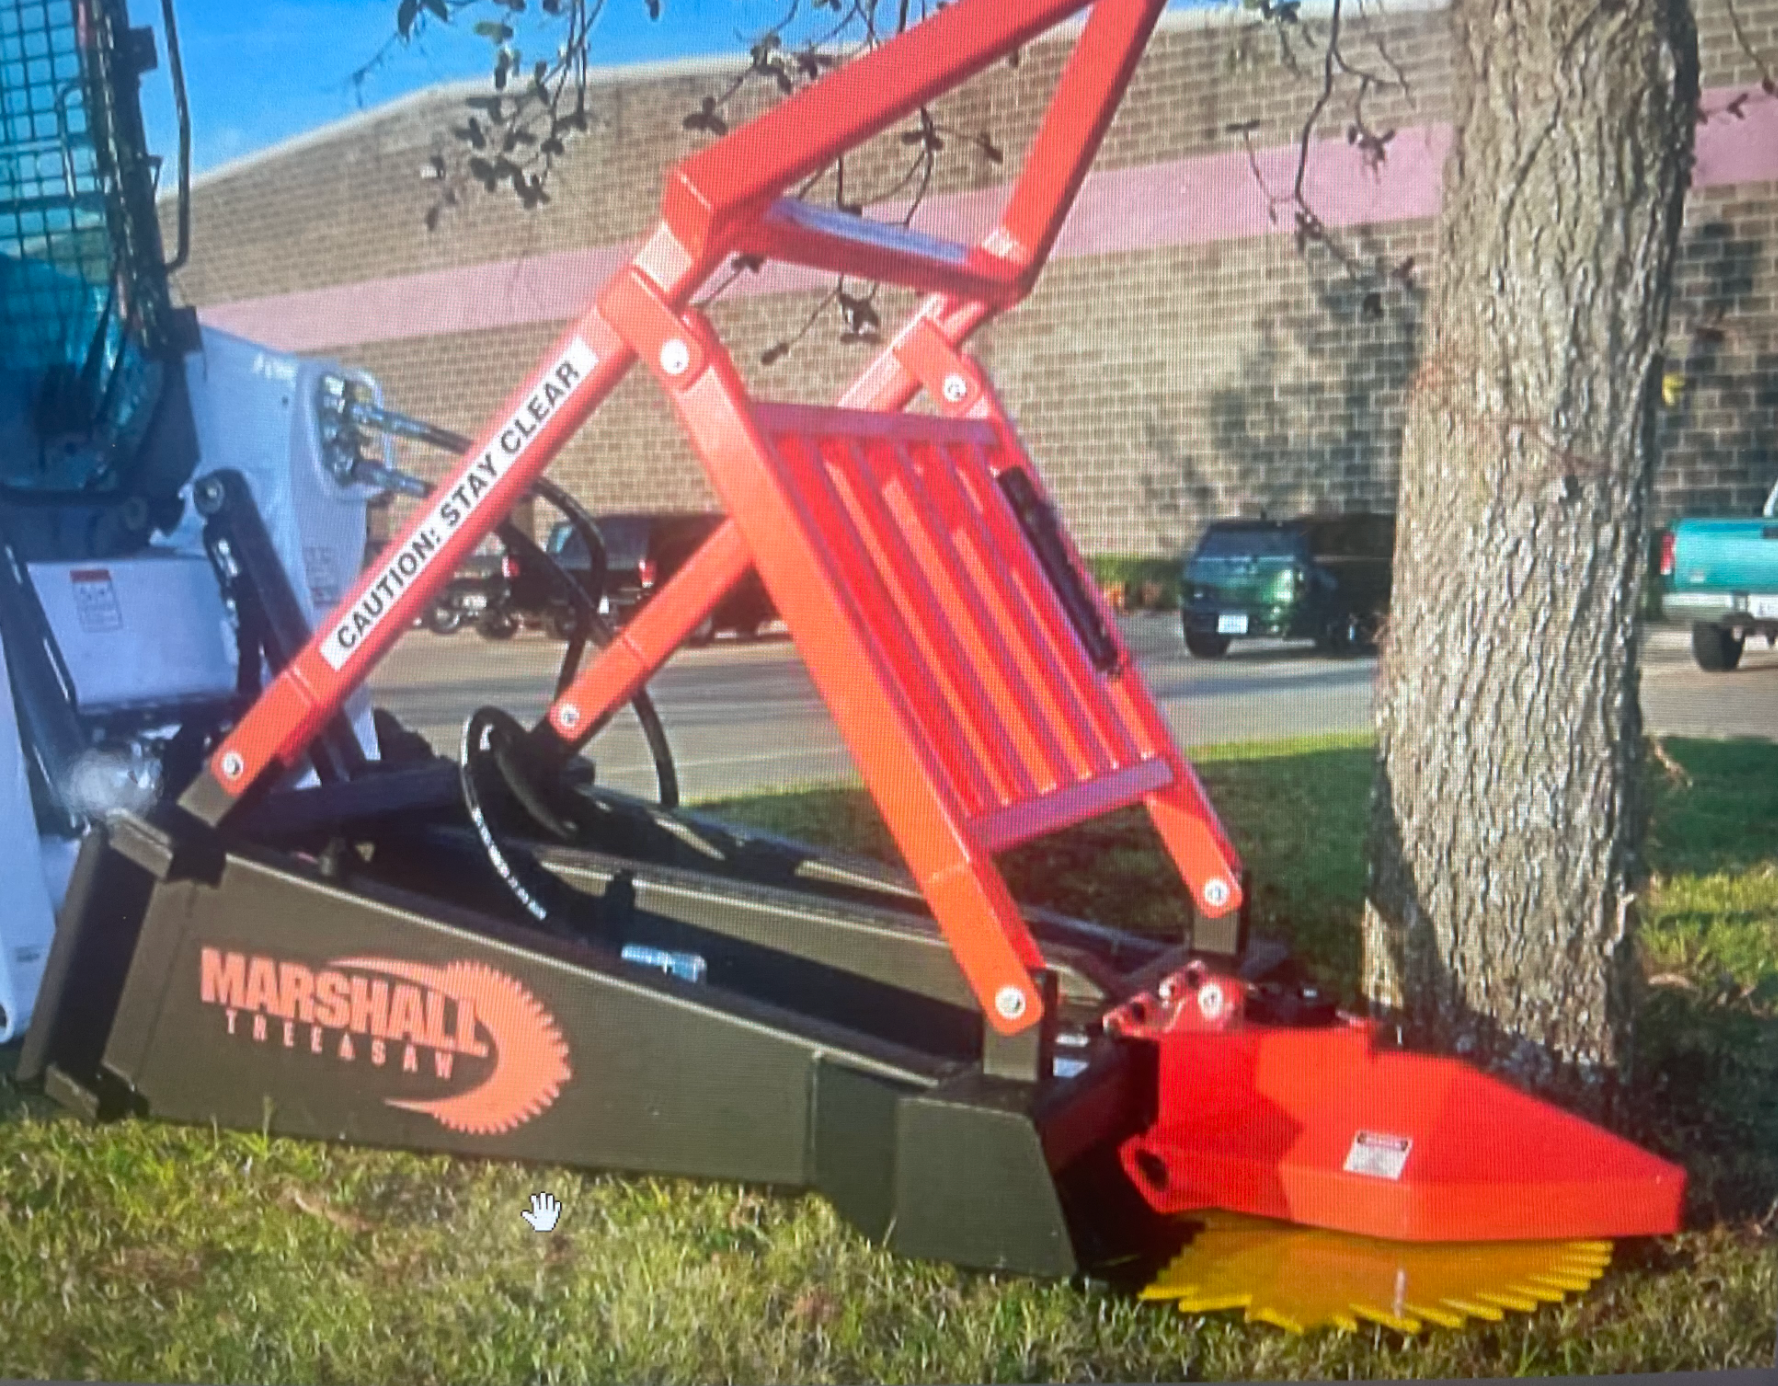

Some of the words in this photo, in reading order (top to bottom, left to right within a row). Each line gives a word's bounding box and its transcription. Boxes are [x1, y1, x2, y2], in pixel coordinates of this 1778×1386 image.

[337, 529, 441, 648] CAUTION:
[441, 453, 498, 526] STAY
[501, 361, 580, 452] CLEAR
[201, 947, 489, 1057] MARSHALL
